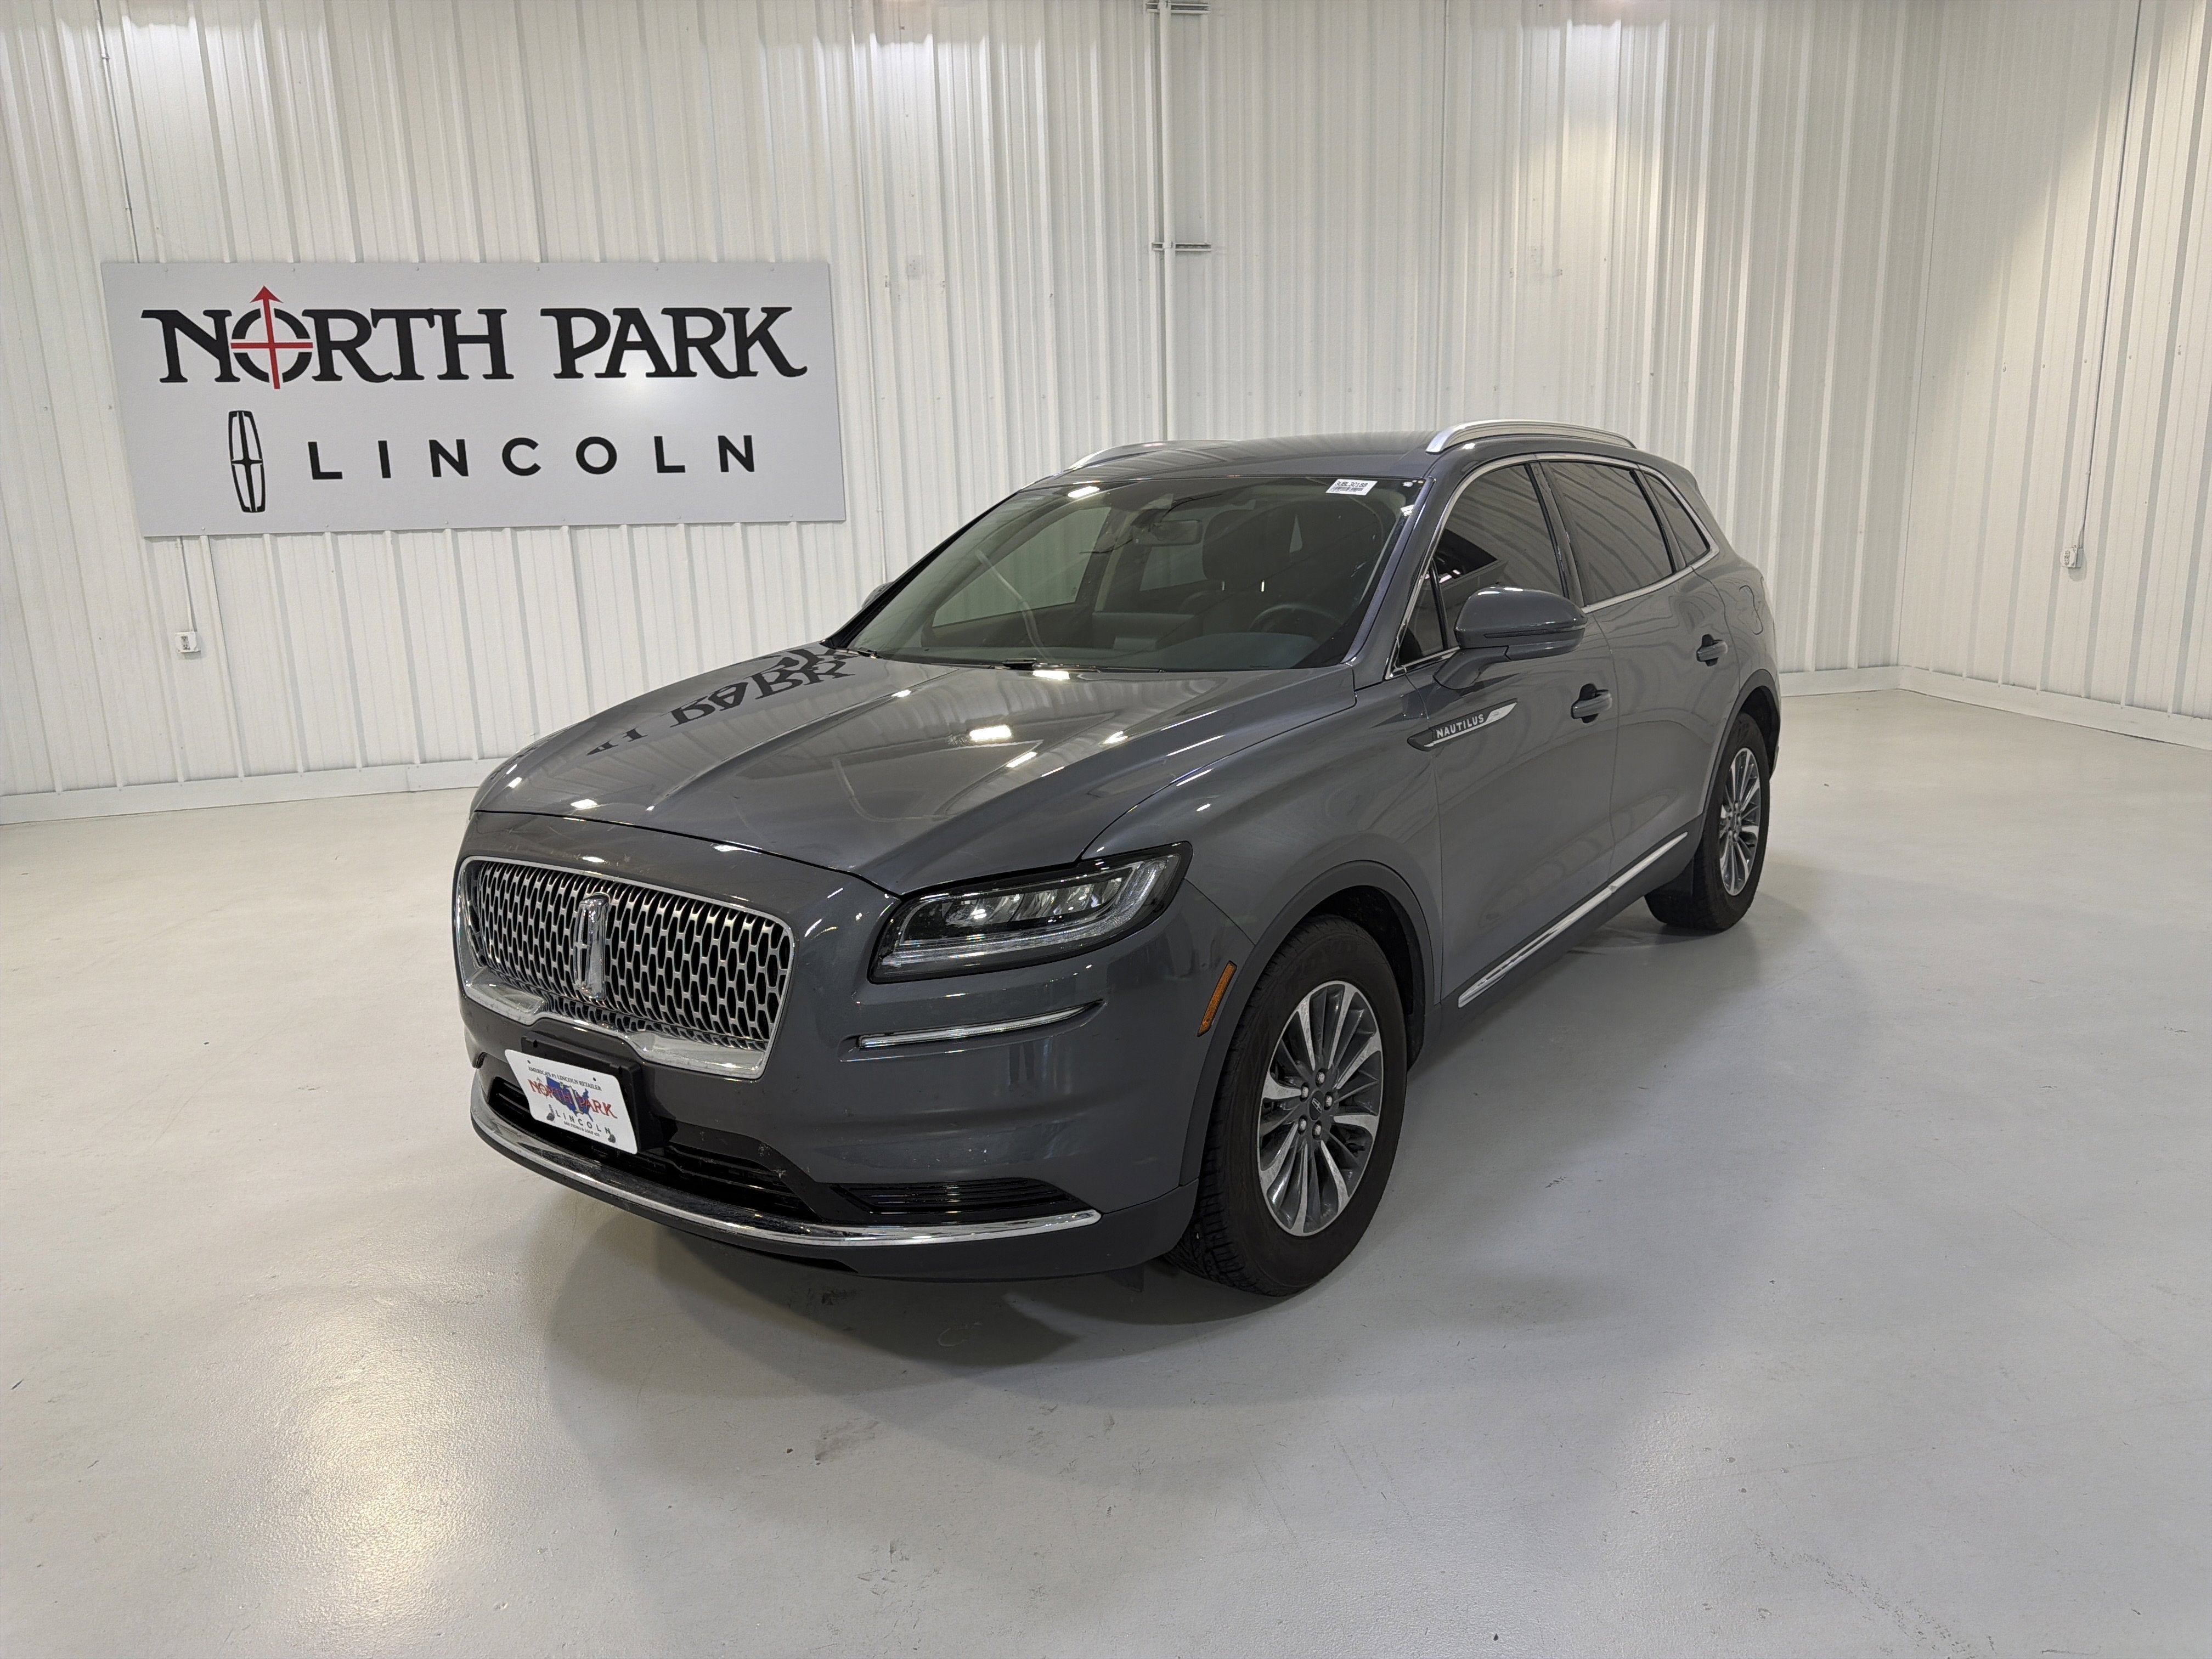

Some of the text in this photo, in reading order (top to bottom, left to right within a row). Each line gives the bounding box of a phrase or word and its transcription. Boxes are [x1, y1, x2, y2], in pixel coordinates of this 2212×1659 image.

[141, 306, 808, 384] NORTH PARK
[308, 435, 755, 480] LINCOLN
[1436, 714, 1485, 738] NAUTILUS
[528, 1066, 550, 1076] AMERICA'S
[557, 1074, 579, 1085] LINCOLN
[579, 1080, 602, 1091] RETAILER
[527, 1079, 618, 1119] NORTH PARK
[555, 1109, 611, 1134] LINCOLN
